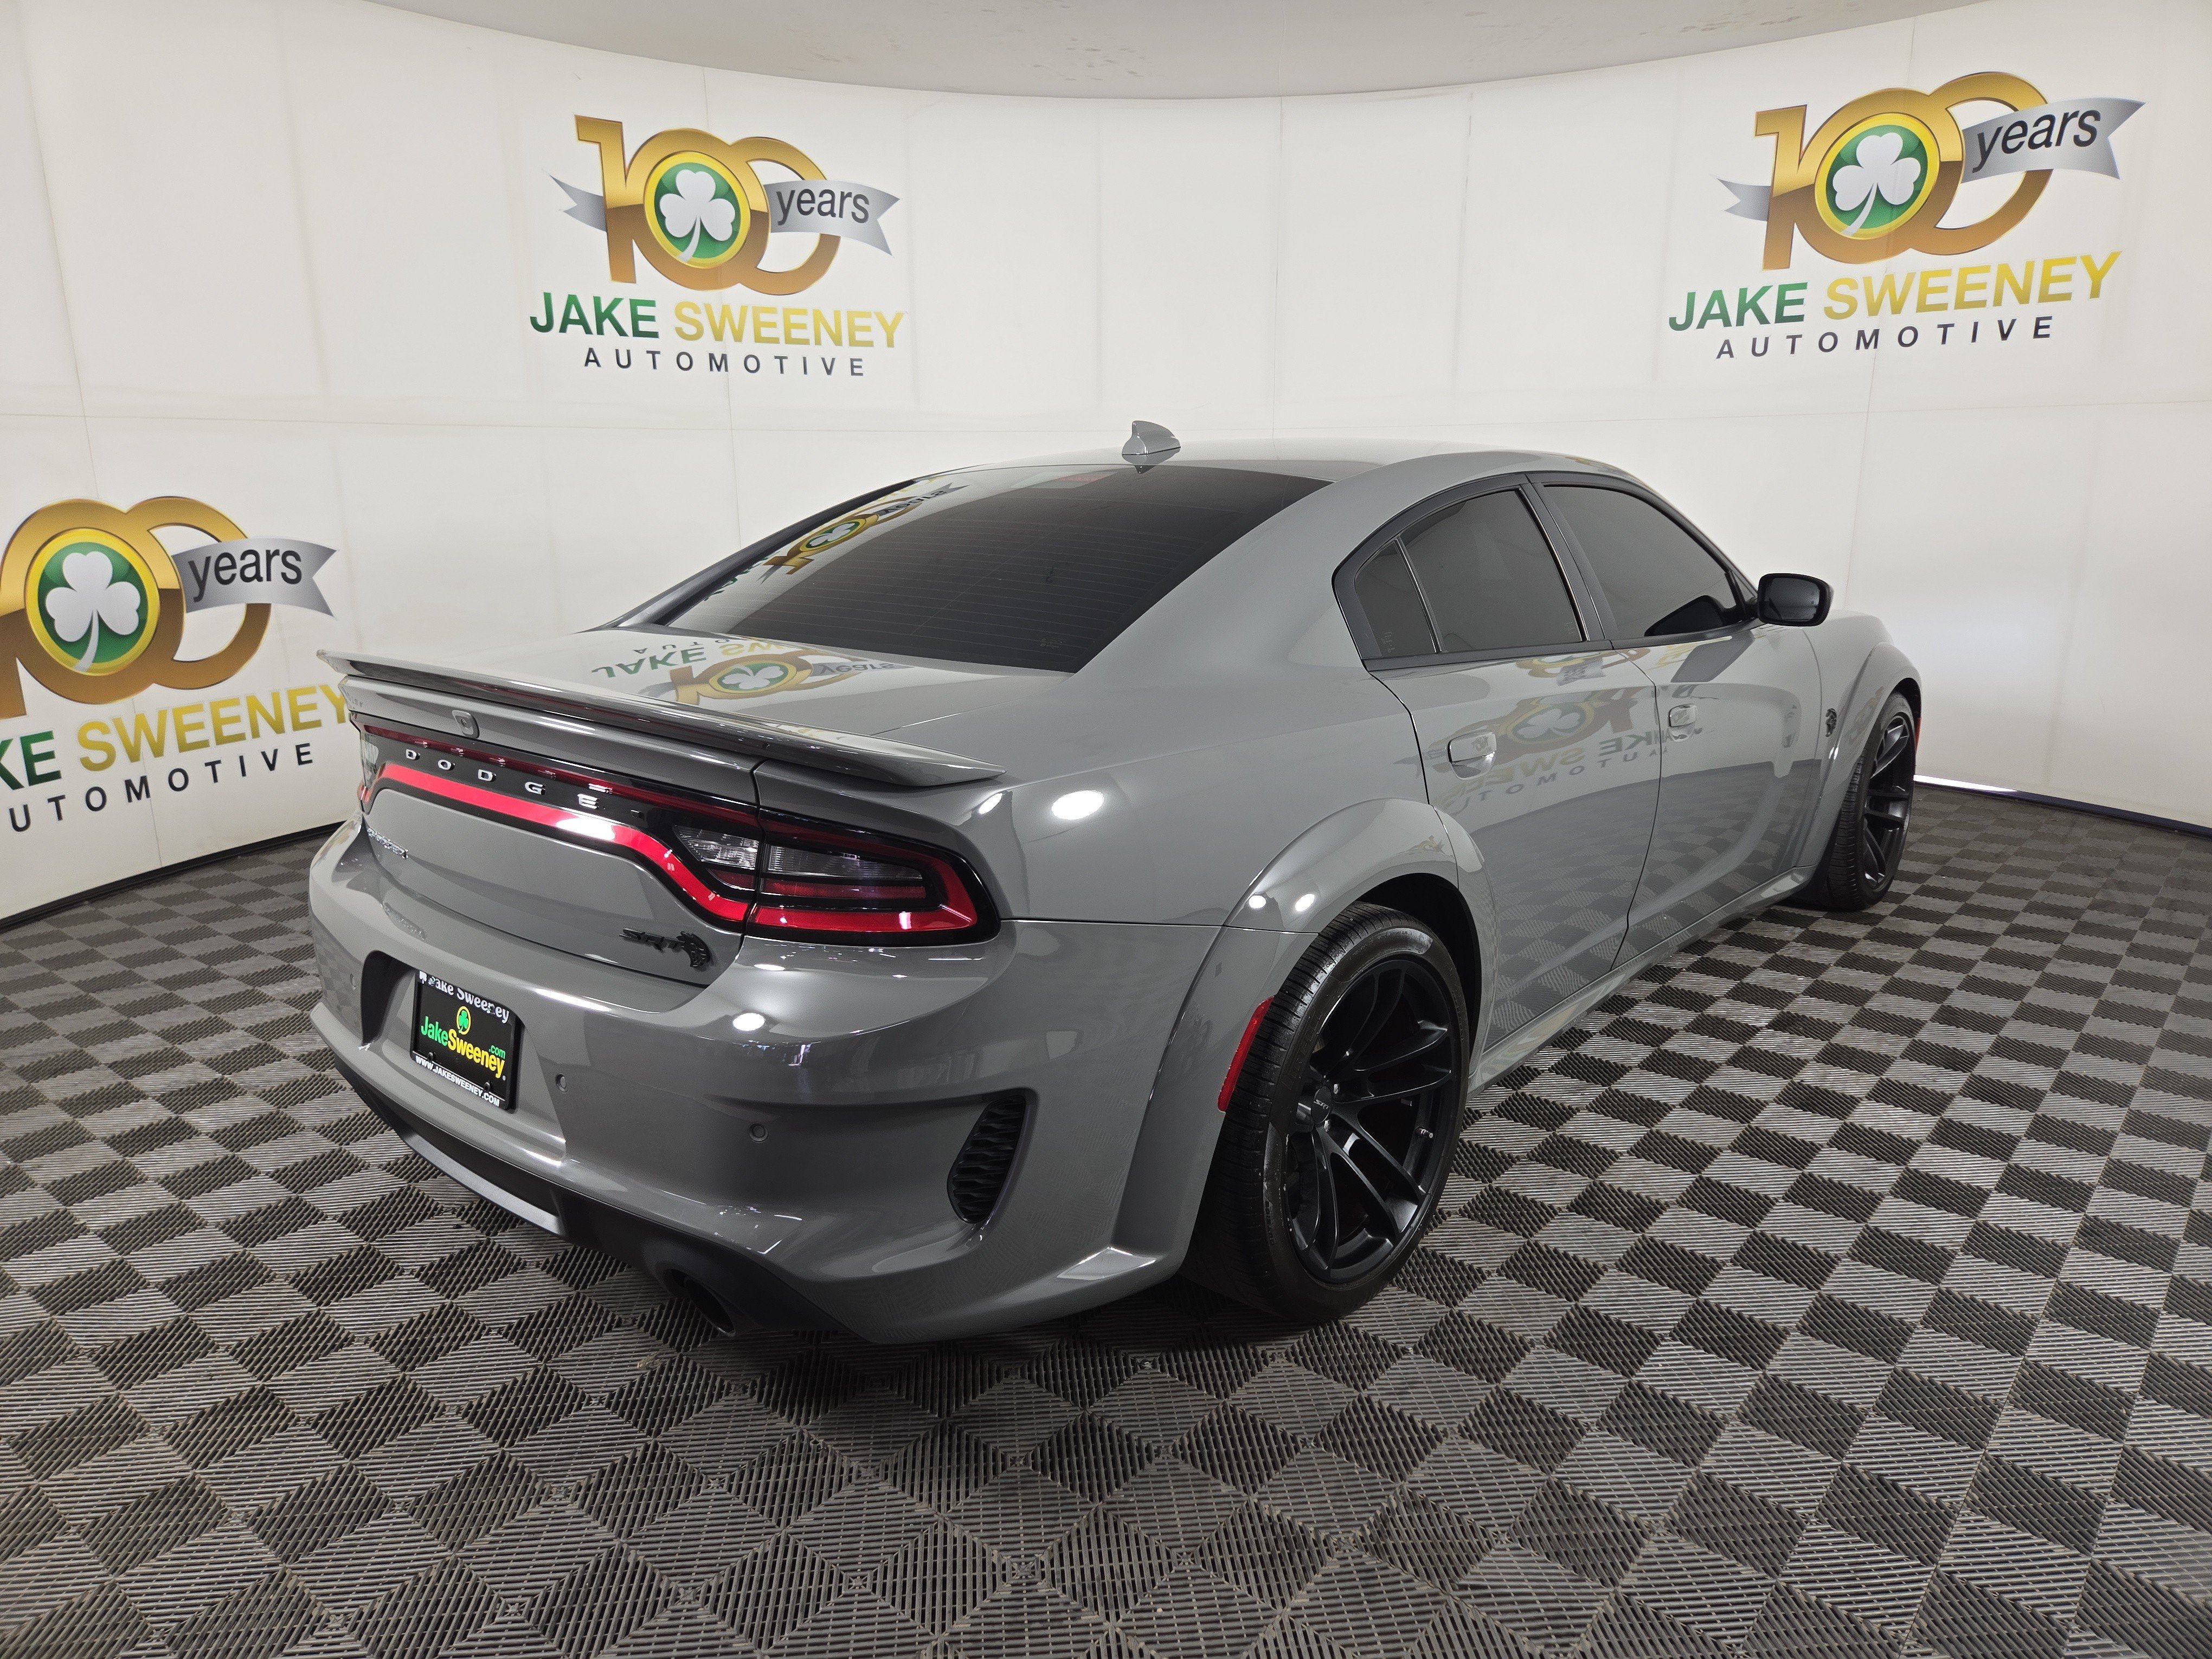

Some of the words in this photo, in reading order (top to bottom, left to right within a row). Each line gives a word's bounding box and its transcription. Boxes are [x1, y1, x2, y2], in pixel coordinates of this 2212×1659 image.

[1972, 109, 2101, 173] years
[1754, 71, 2054, 271] 100
[575, 114, 841, 295] 100
[776, 188, 870, 226] years
[530, 292, 659, 339] JAKE
[674, 301, 904, 348] SWEENEY
[1669, 281, 1808, 332] JAKE
[1824, 250, 2122, 320] SWEENEY
[584, 347, 864, 377] AUTOMOTIVE
[1716, 316, 2053, 359] AUTOMOTIVE
[188, 548, 303, 602] years
[0, 496, 272, 720] 00
[0, 730, 62, 790] KE
[77, 684, 346, 772] SWEENEY
[9, 743, 313, 832] UTOMOTIVE
[406, 749, 598, 809] DODGE
[428, 976, 454, 995] ake
[489, 1044, 506, 1059] .com
[415, 1055, 500, 1107] WWW.JAKESWEENEY.COM
